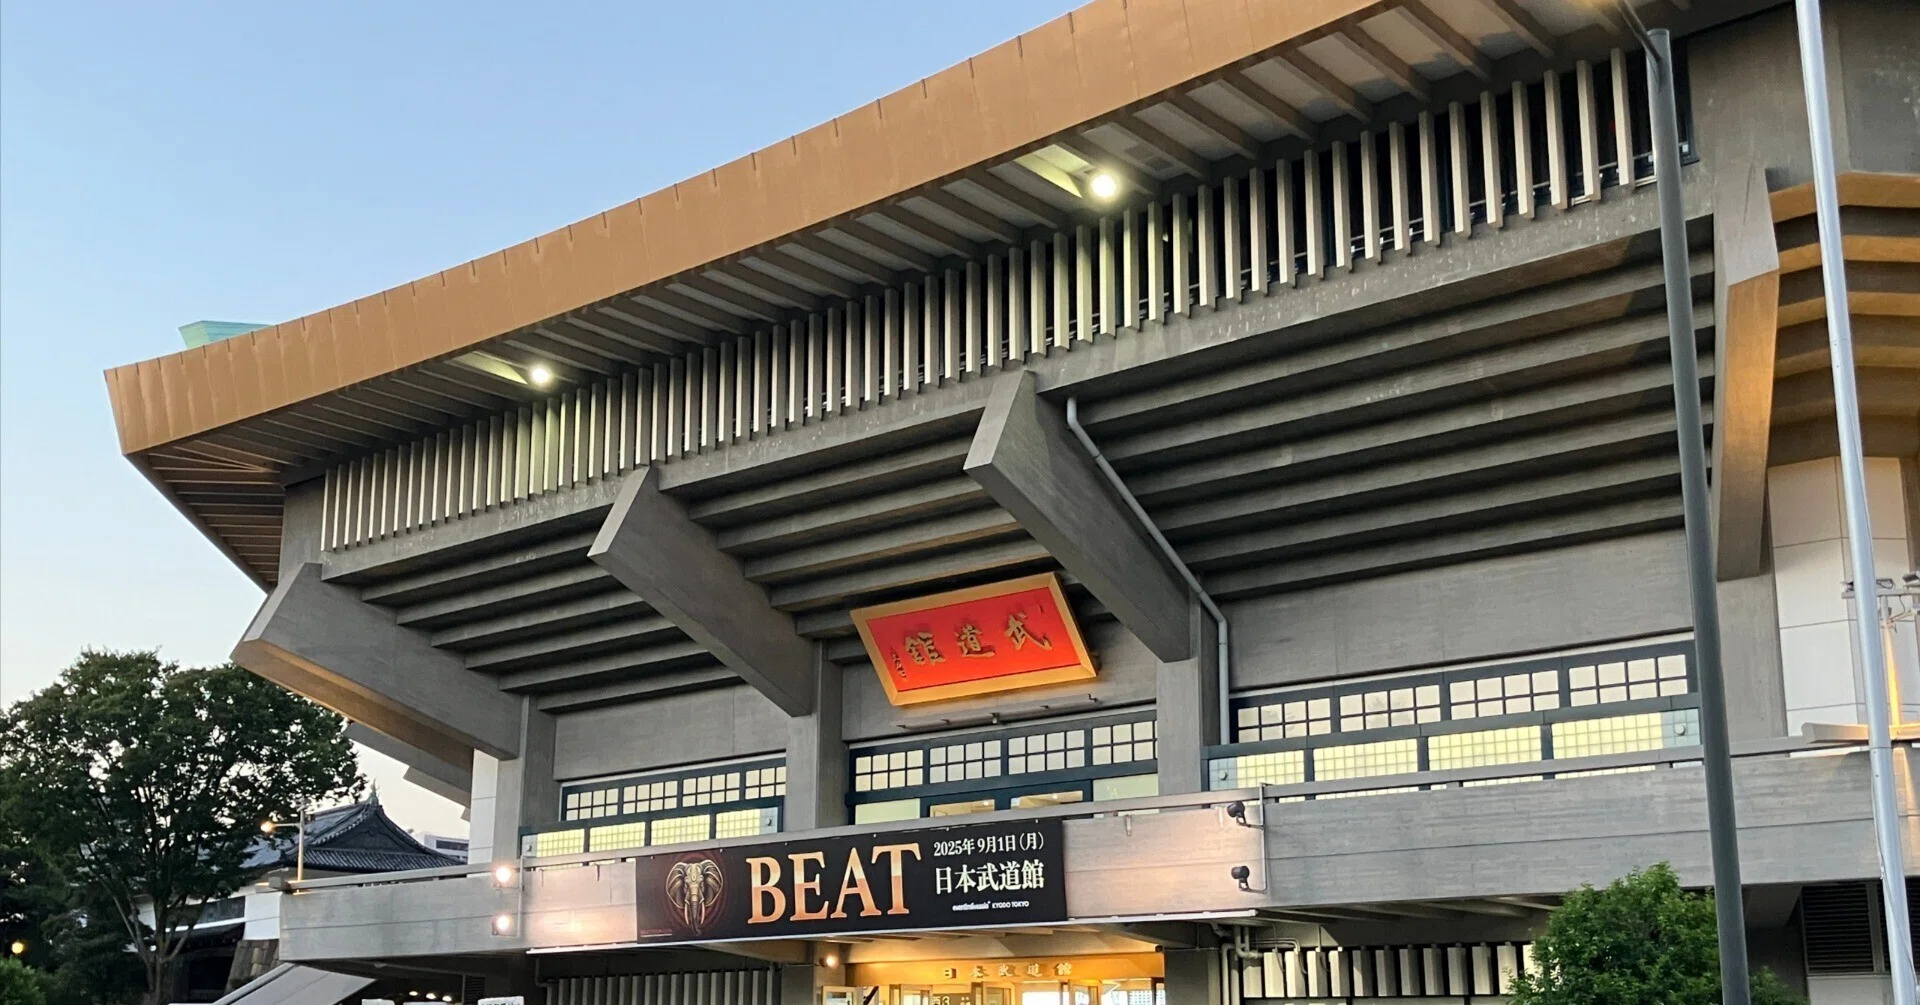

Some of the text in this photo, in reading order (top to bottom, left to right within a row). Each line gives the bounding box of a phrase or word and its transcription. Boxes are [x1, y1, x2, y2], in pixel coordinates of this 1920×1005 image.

[745, 842, 922, 924] BEAT
[935, 858, 1045, 895] 日本武道館
[1011, 900, 1030, 908] TOKYO
[944, 962, 1072, 980] 日本武道館
